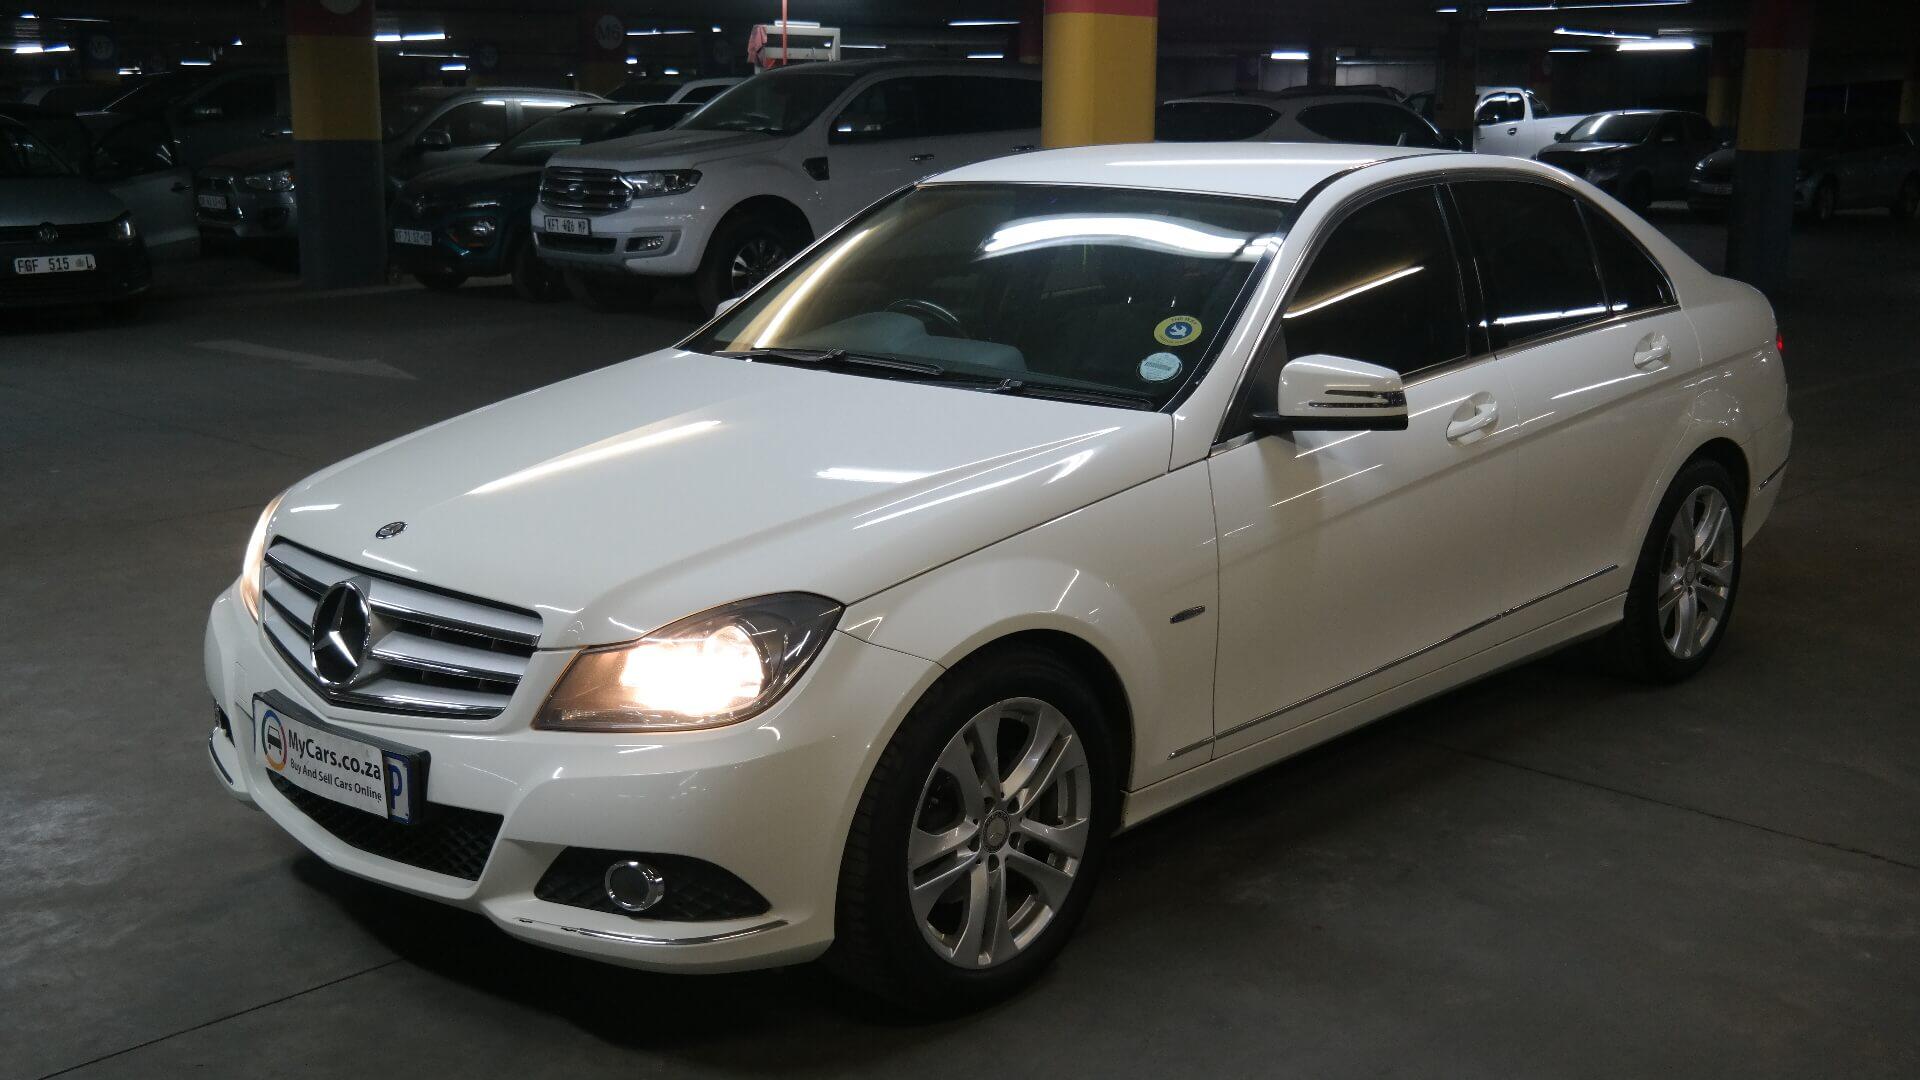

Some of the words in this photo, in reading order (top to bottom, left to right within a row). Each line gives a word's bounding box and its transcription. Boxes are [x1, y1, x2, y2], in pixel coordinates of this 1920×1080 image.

[17, 259, 38, 273] FGF
[48, 257, 70, 271] 515
[86, 256, 93, 269] L
[288, 729, 381, 780] MyCars.co.za
[291, 758, 302, 774] Buy
[303, 765, 317, 780] And
[319, 771, 333, 785] Sell
[334, 776, 352, 791] Cars
[355, 783, 382, 801] Online
[389, 764, 403, 810] P
